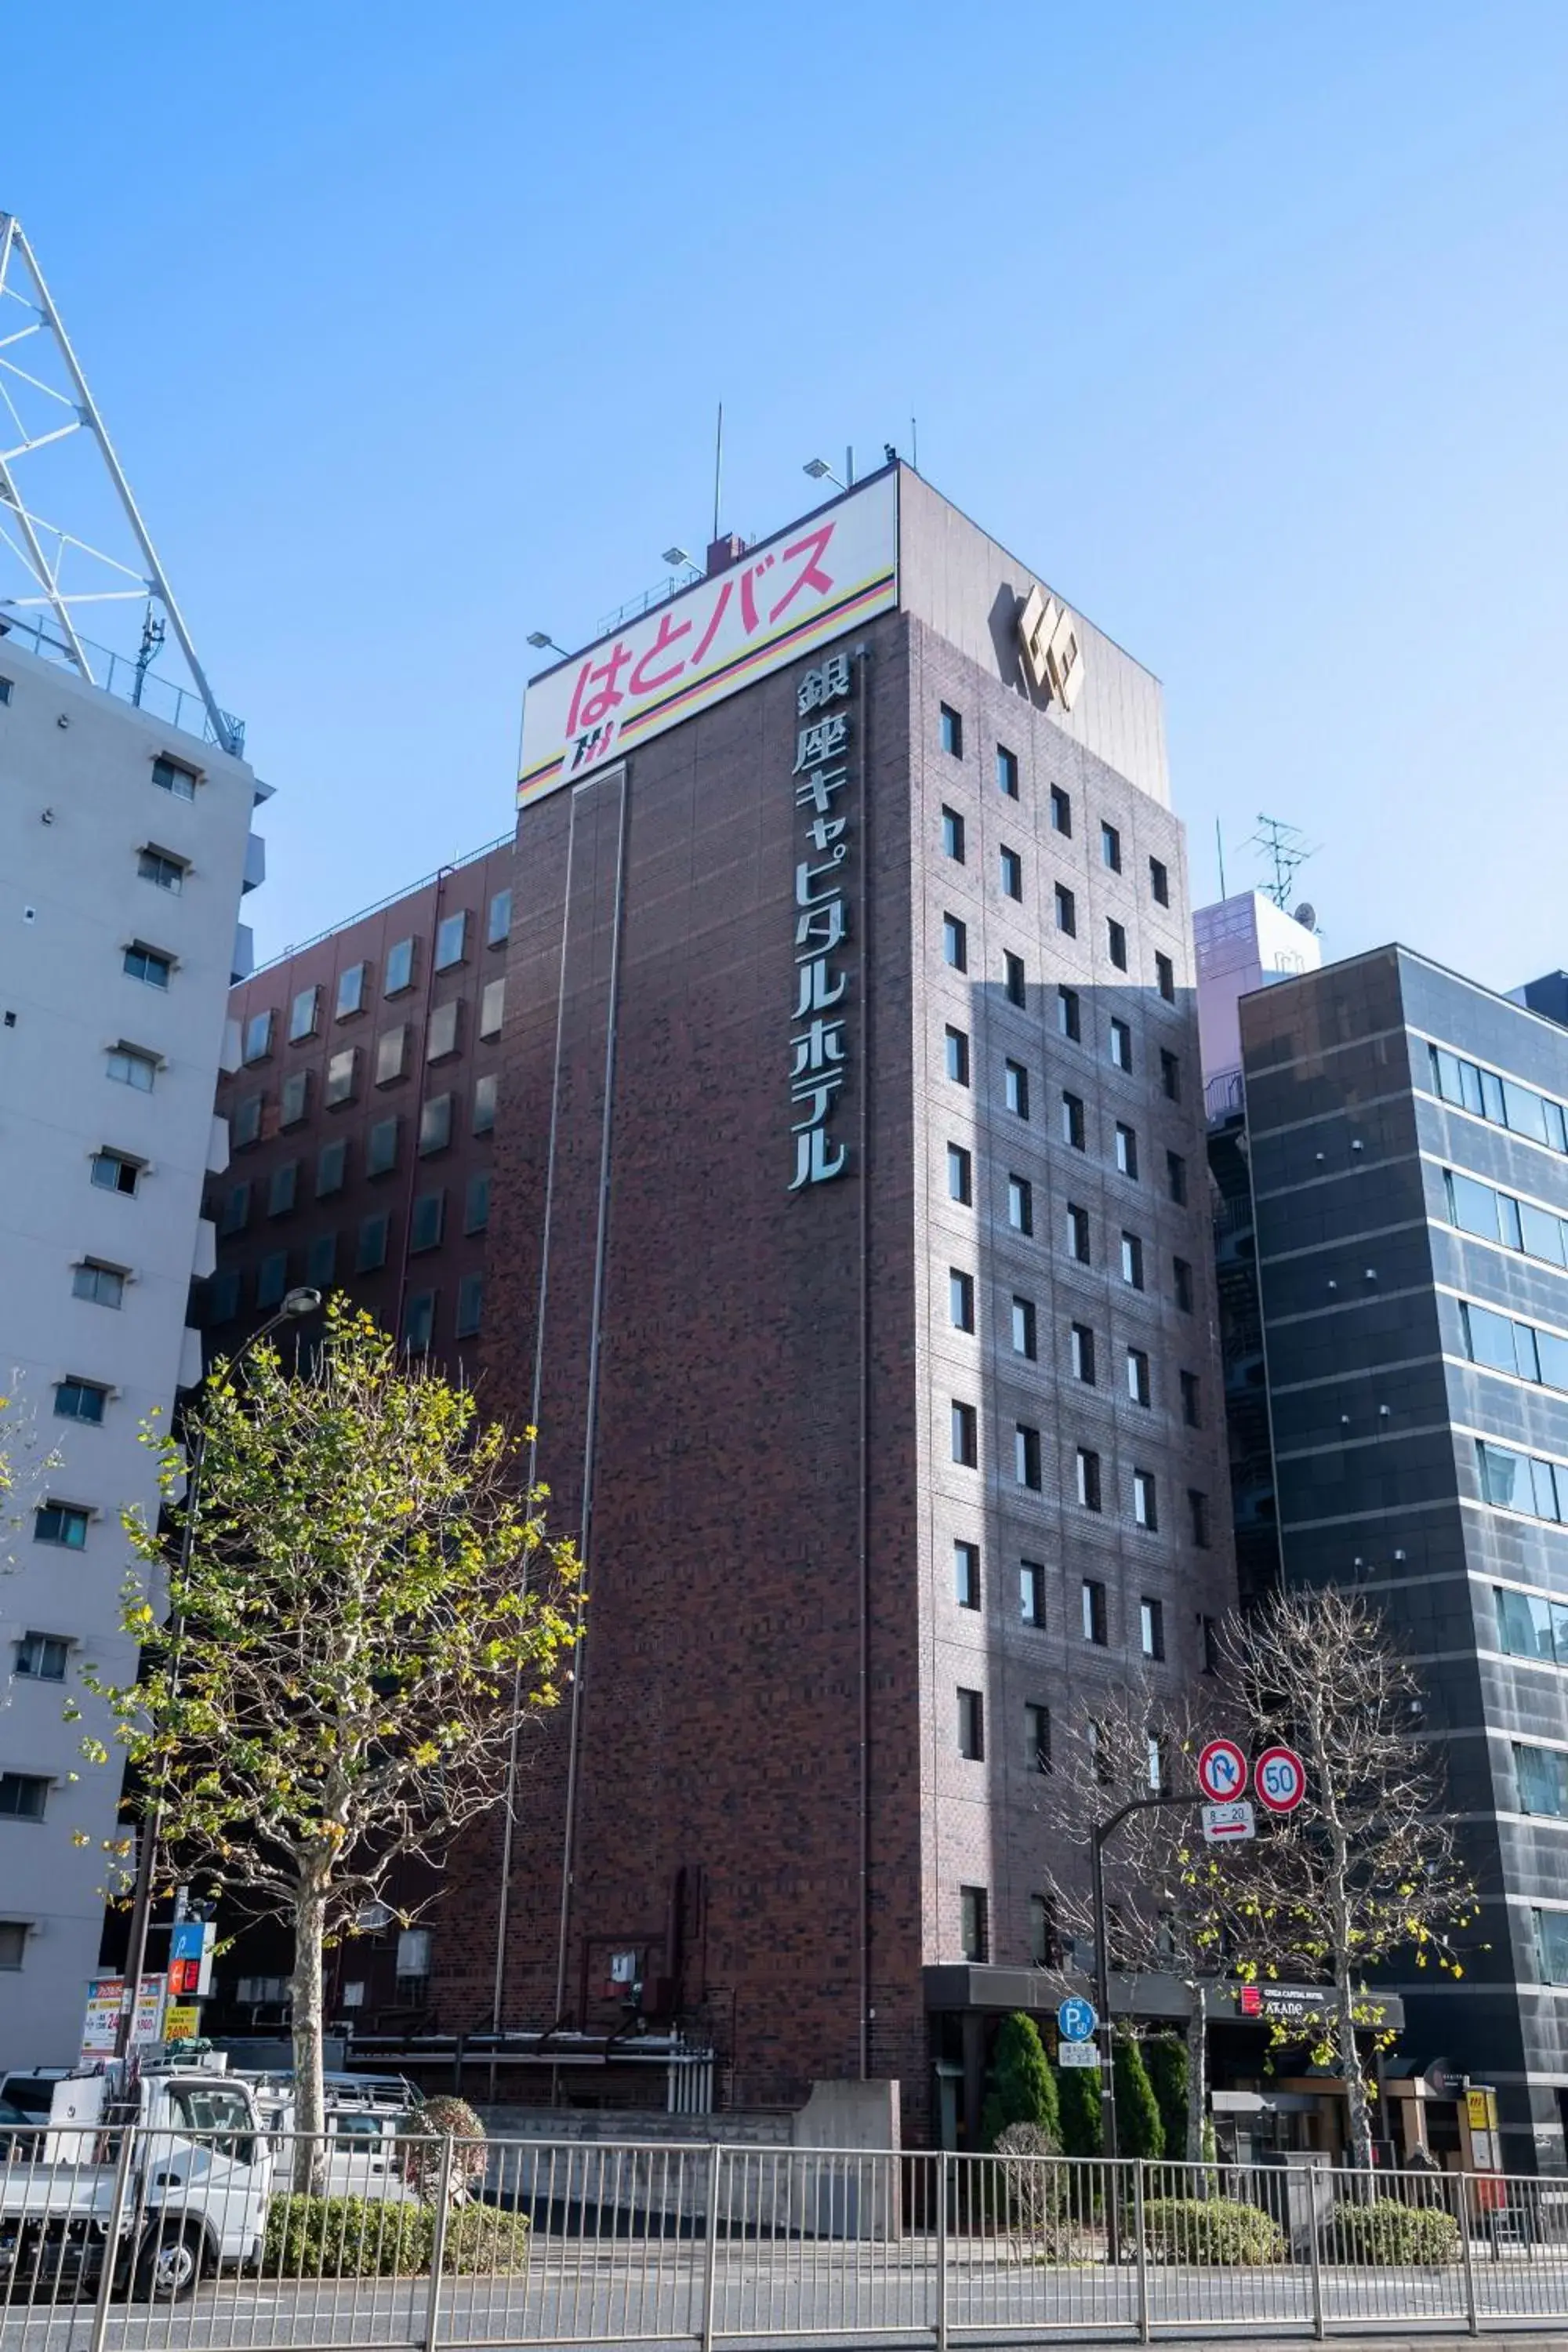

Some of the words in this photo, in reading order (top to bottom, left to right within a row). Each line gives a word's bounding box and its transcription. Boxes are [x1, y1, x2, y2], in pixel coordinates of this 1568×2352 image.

[565, 521, 836, 739] はとバス
[786, 652, 849, 1191] 銀座キャピタルホテル
[1265, 1765, 1294, 1795] 50
[1065, 2008, 1080, 2034] P
